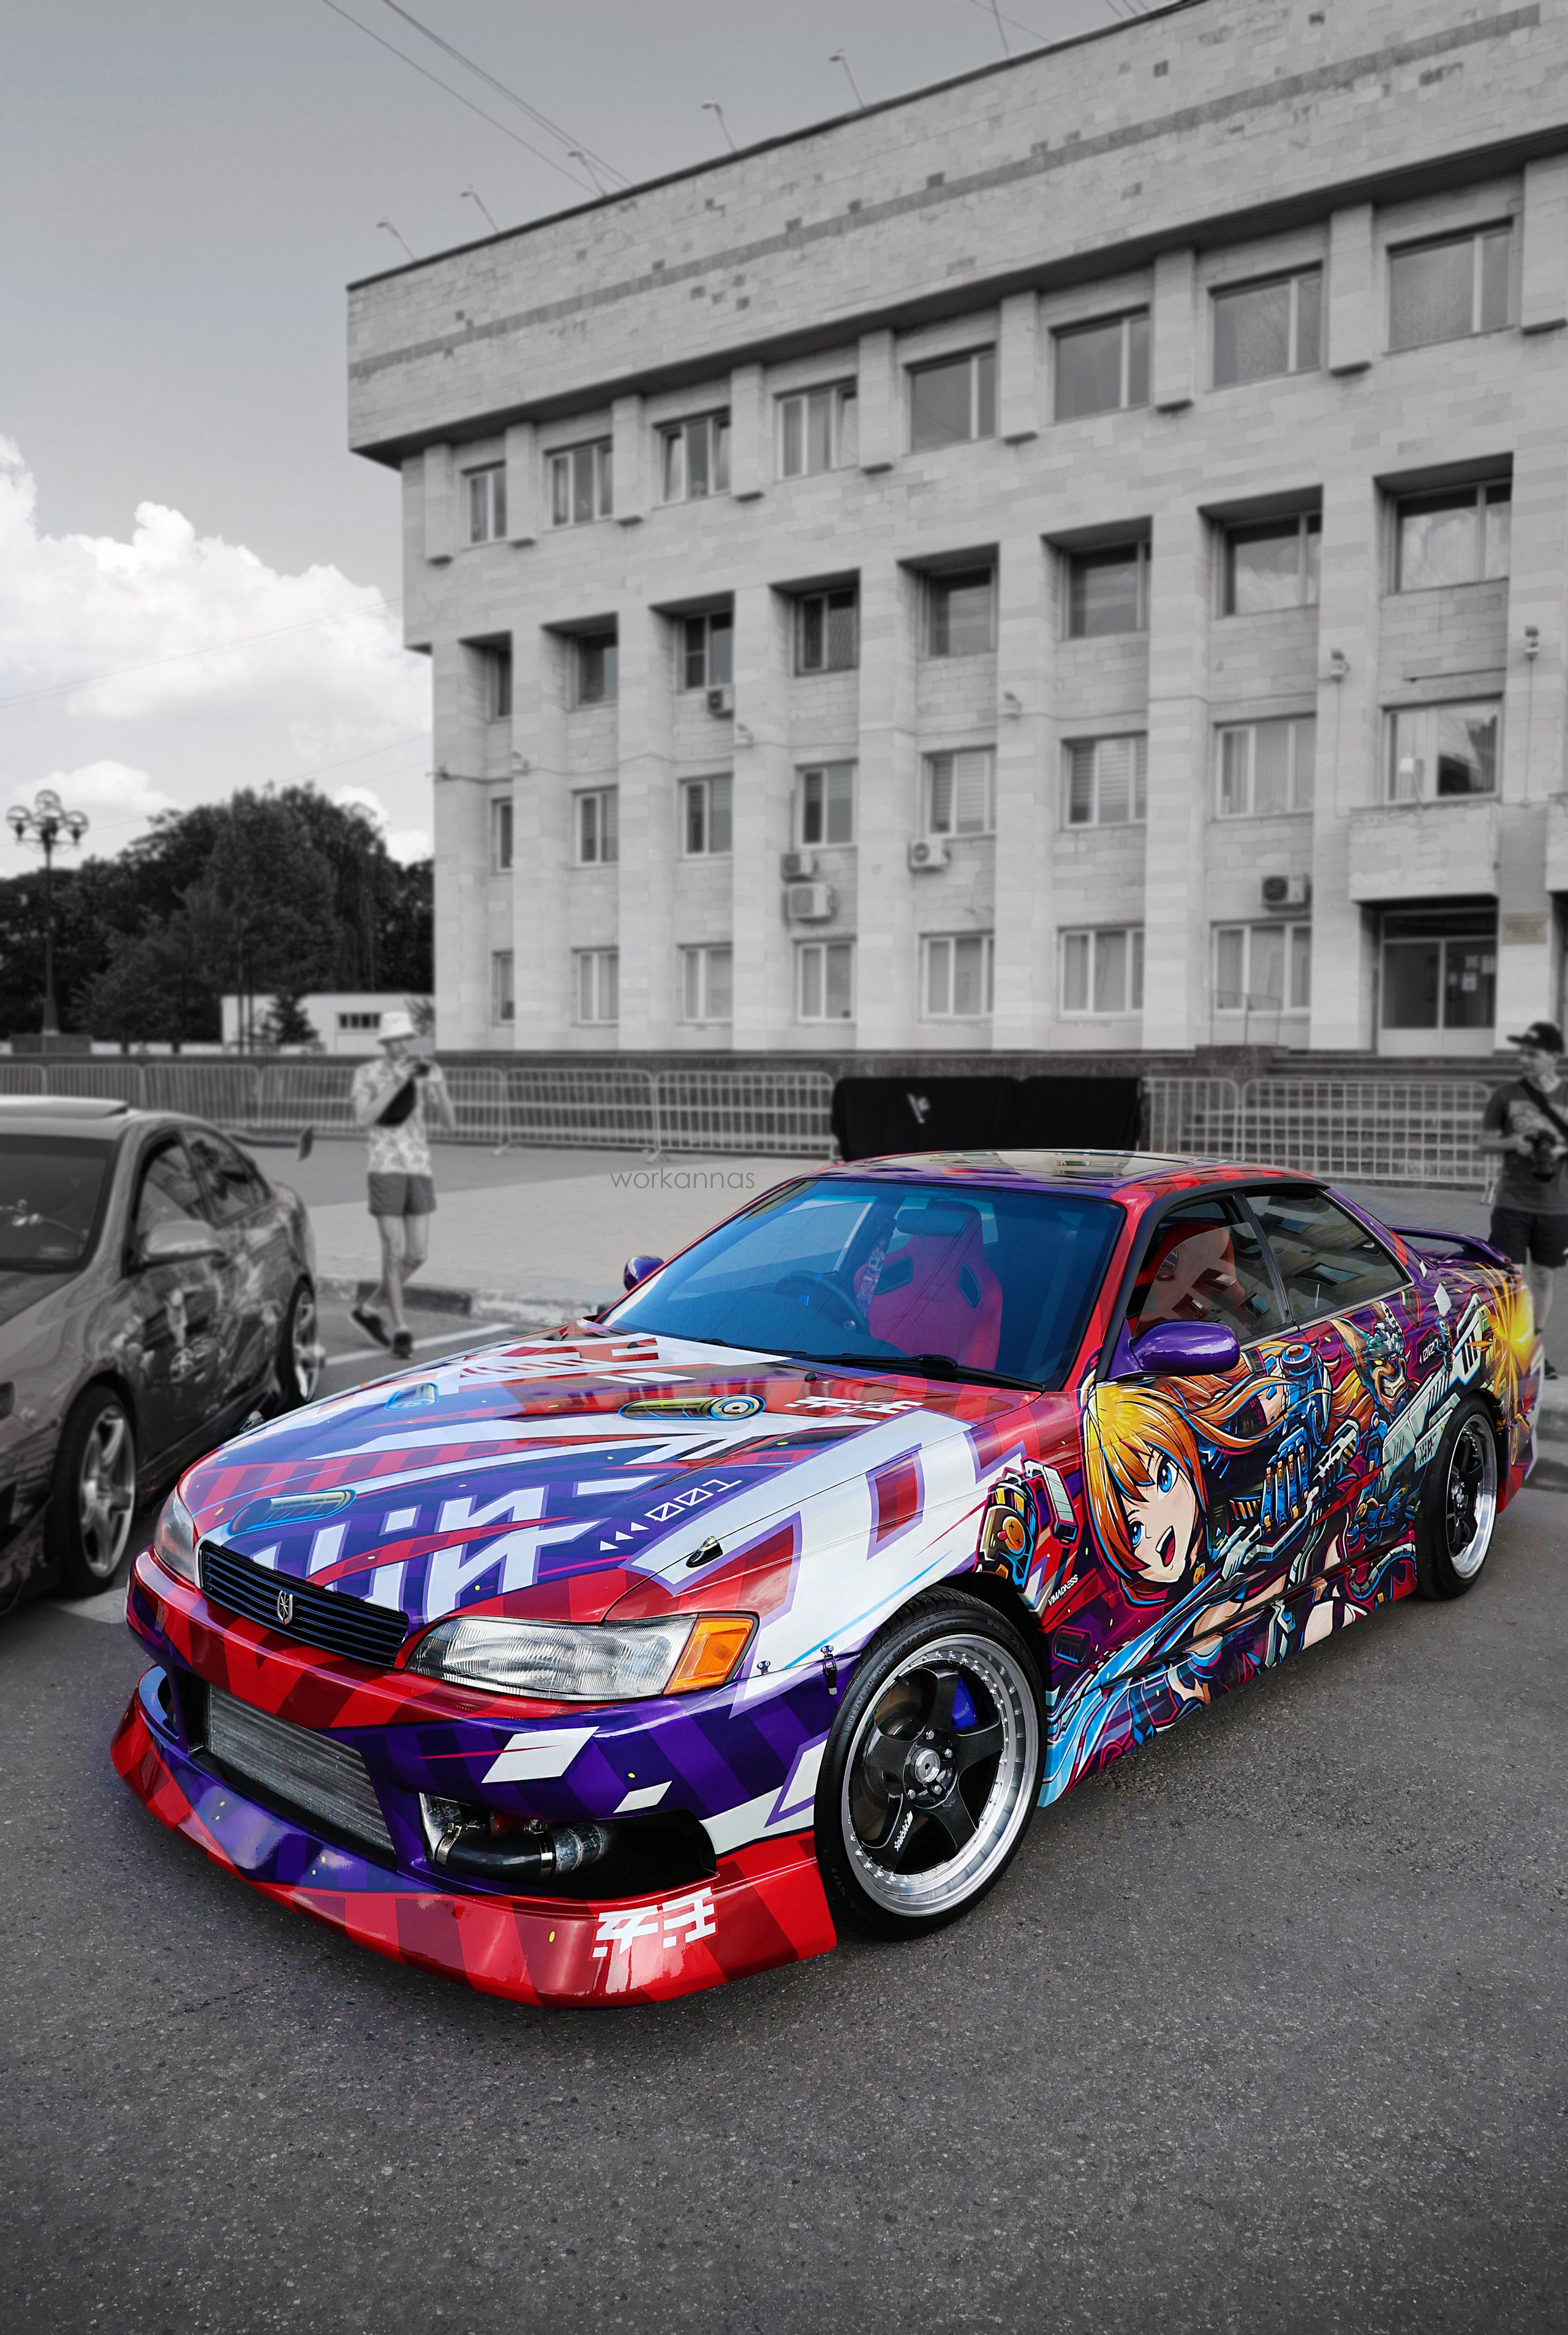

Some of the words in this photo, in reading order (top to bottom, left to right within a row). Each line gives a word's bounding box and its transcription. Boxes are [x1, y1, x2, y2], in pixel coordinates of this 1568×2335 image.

[644, 1479, 742, 1522] 001
[1047, 1574, 1078, 1606] VIMADNESS
[986, 1616, 1036, 1667] NEXE
[894, 1822, 910, 1852] WORK
